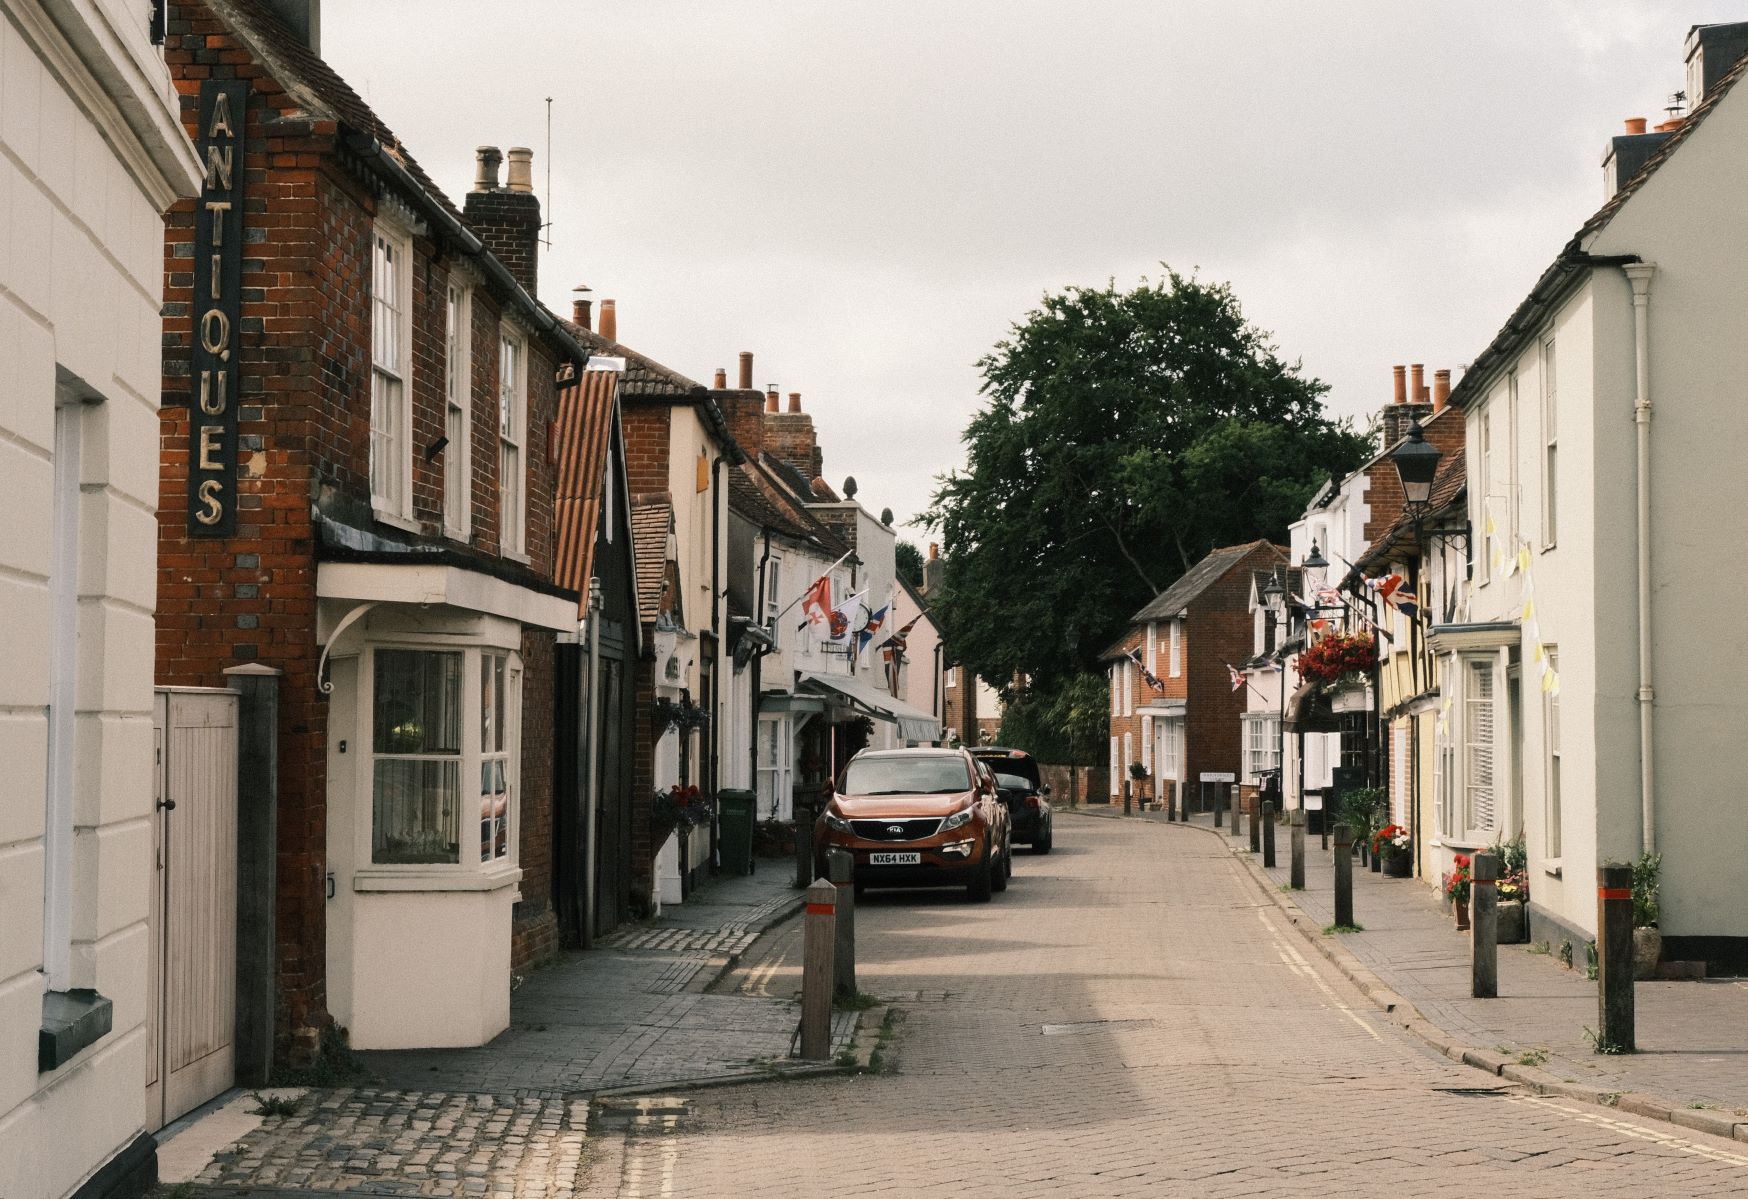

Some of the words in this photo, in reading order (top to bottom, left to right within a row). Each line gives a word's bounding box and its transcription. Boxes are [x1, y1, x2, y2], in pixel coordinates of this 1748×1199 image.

[195, 92, 235, 525] ANTIQUES
[873, 854, 897, 863] NX64
[899, 854, 917, 863] HXK
